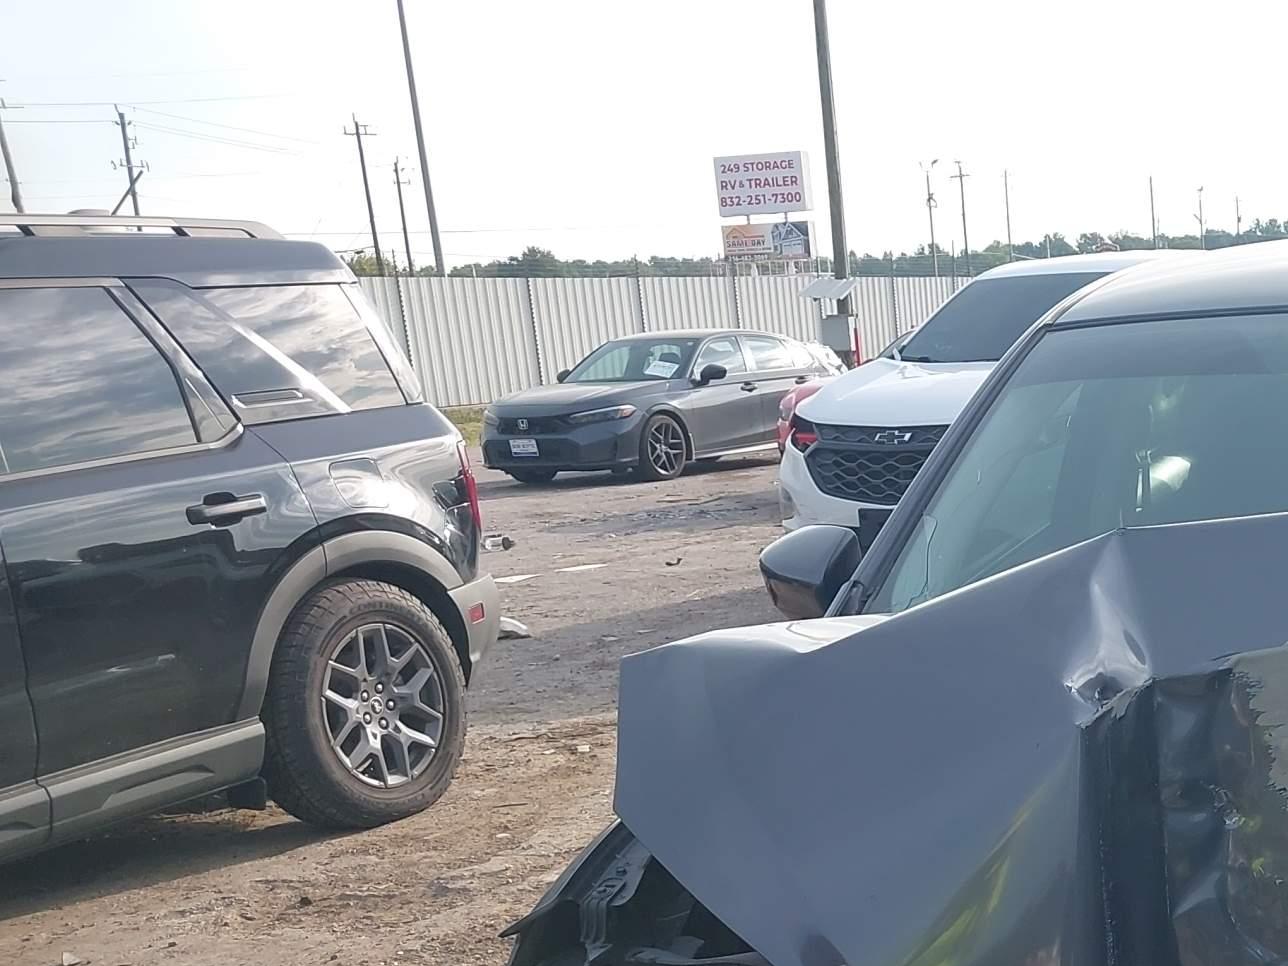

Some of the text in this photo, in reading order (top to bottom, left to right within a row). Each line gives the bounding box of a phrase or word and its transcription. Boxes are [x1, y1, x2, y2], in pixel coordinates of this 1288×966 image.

[720, 159, 795, 174] 249 STORAGE
[720, 175, 799, 191] RV & TRAILER
[720, 191, 802, 207] 832-251-7300
